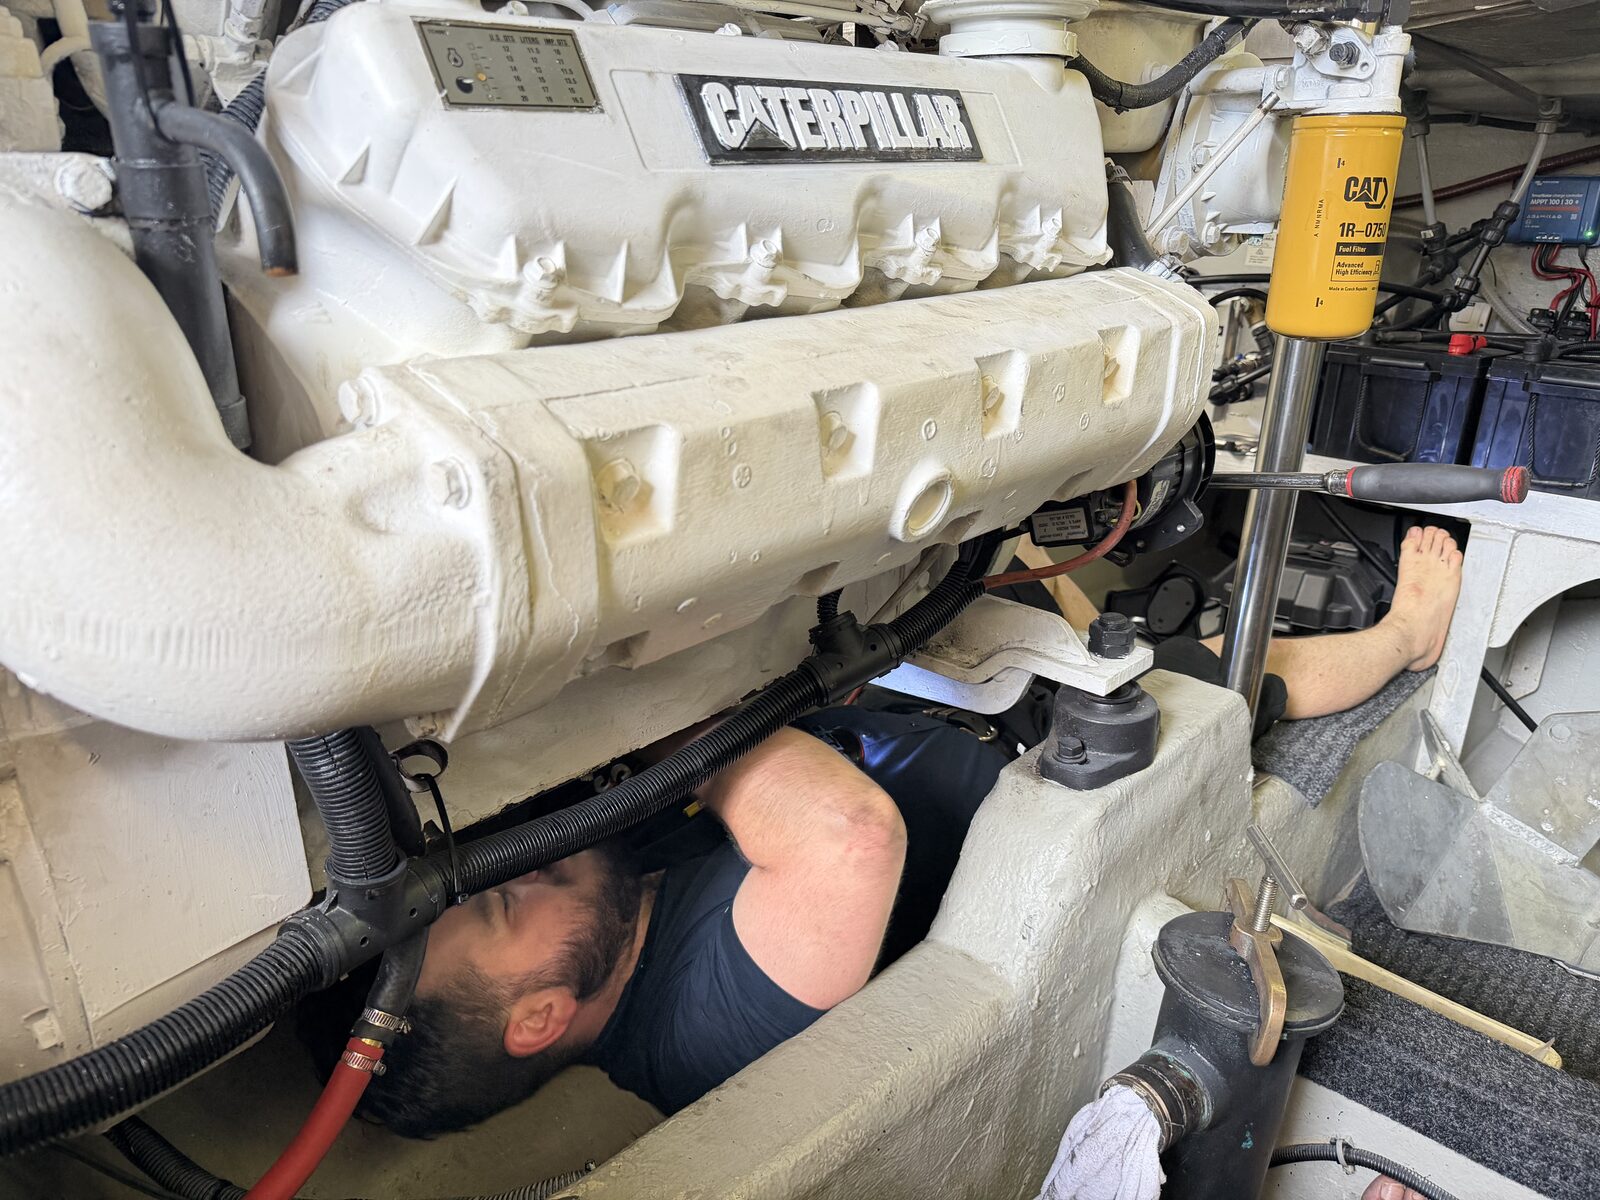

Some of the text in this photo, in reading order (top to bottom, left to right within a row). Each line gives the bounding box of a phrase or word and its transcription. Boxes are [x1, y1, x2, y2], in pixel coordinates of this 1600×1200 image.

[519, 36, 541, 45] LITERS
[701, 82, 972, 150] CATERPILLAR
[1344, 176, 1382, 203] CAT
[1339, 245, 1367, 253] Fuel Filter
